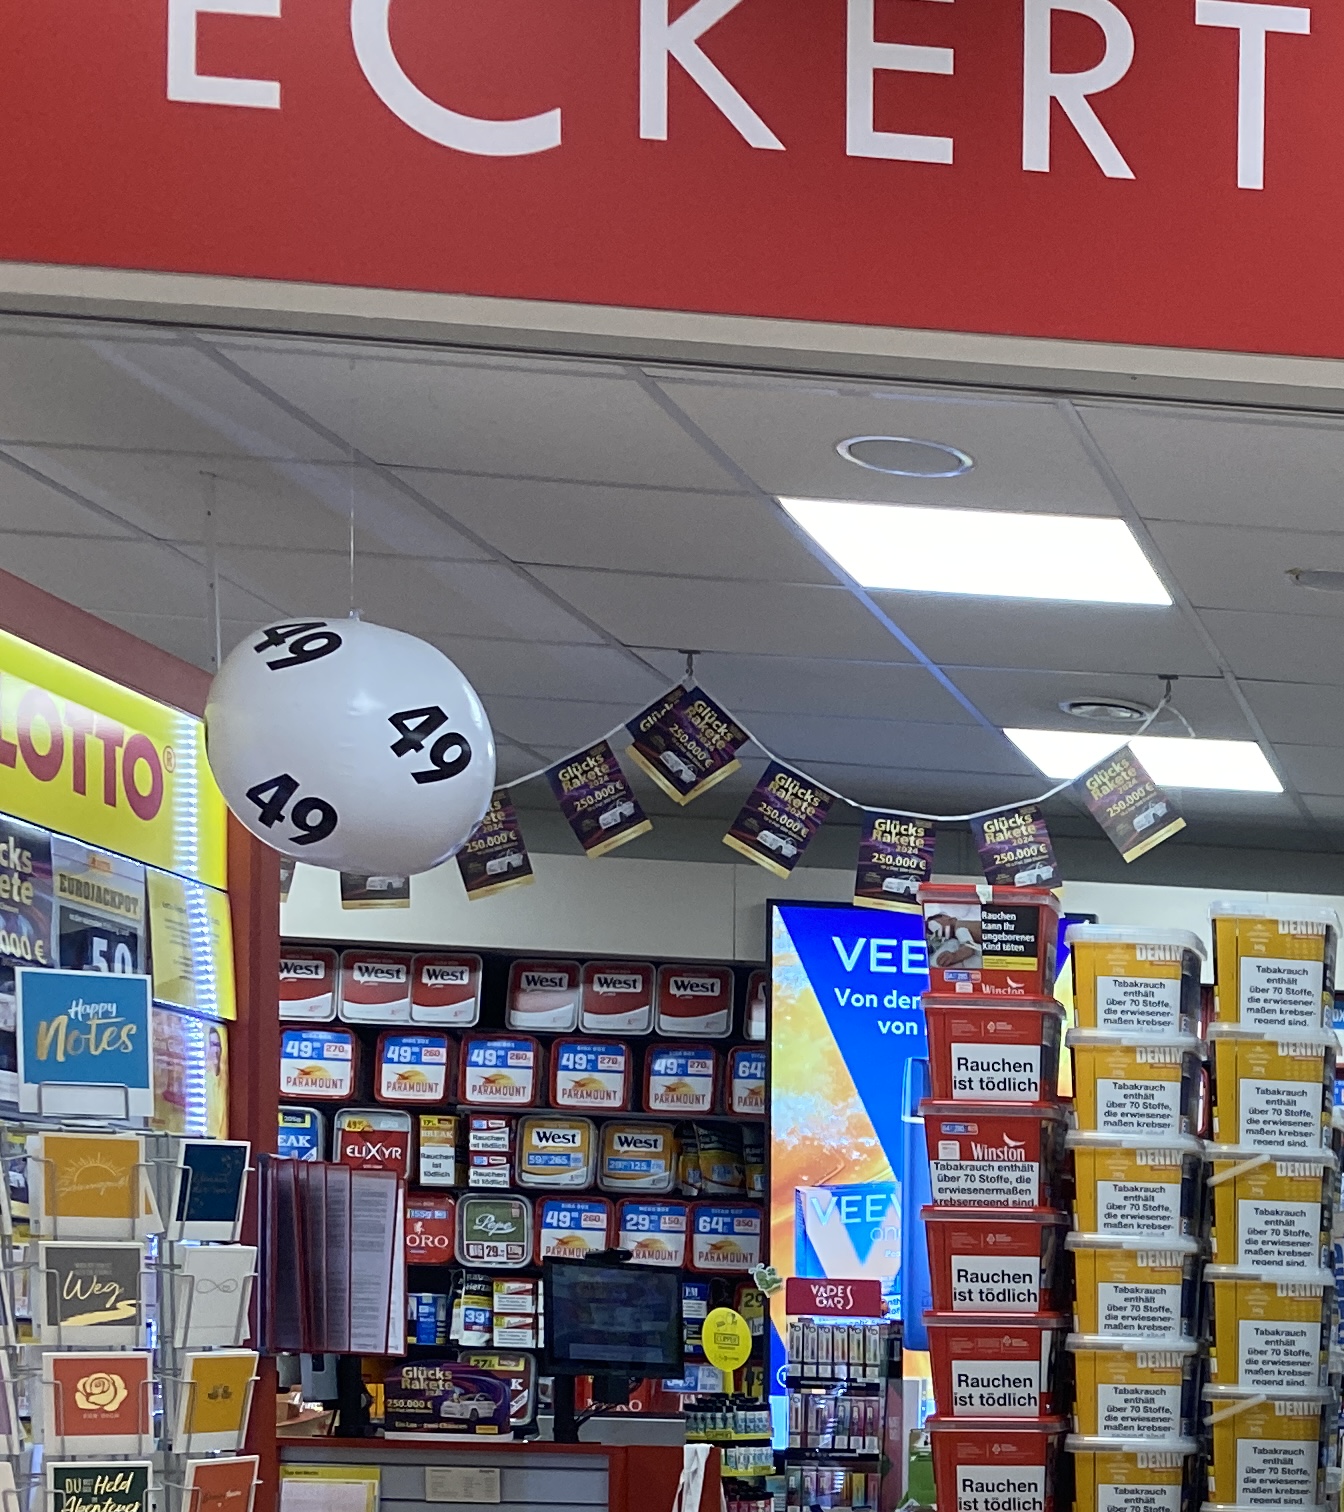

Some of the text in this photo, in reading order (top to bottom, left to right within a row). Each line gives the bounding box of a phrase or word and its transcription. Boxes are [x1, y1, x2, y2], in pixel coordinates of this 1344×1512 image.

[166, 0, 1310, 190] ECKERT
[254, 621, 342, 671] 49
[388, 705, 473, 785] 49
[774, 772, 820, 807] Glücks
[767, 782, 815, 817] Rakete
[245, 773, 338, 846] 49
[874, 819, 925, 837] Glücks
[872, 830, 924, 848] Rakete
[871, 853, 918, 869] 250.000
[57, 873, 139, 916] EUROJACKPOT
[832, 936, 929, 974] VEE
[358, 965, 402, 980] West
[427, 968, 466, 981] West
[834, 987, 878, 1008] Von
[67, 998, 118, 1021] Happy
[877, 1020, 918, 1036] von
[36, 1014, 137, 1062] Notes
[956, 1057, 1034, 1074] Rauchen
[286, 1076, 344, 1090] PARAMOUNT
[953, 1076, 1038, 1093] ist tödlich
[971, 1141, 1026, 1162] Winston
[934, 1161, 1035, 1173] Tabakrauch enthält
[937, 1173, 1013, 1186] über Stoffe,
[937, 1185, 1032, 1197] erwiesenermaßen
[957, 1269, 1033, 1284] Rauchen
[62, 1269, 126, 1308] Weg
[953, 1287, 1038, 1303] ist tödlich
[94, 1471, 135, 1495] Held
